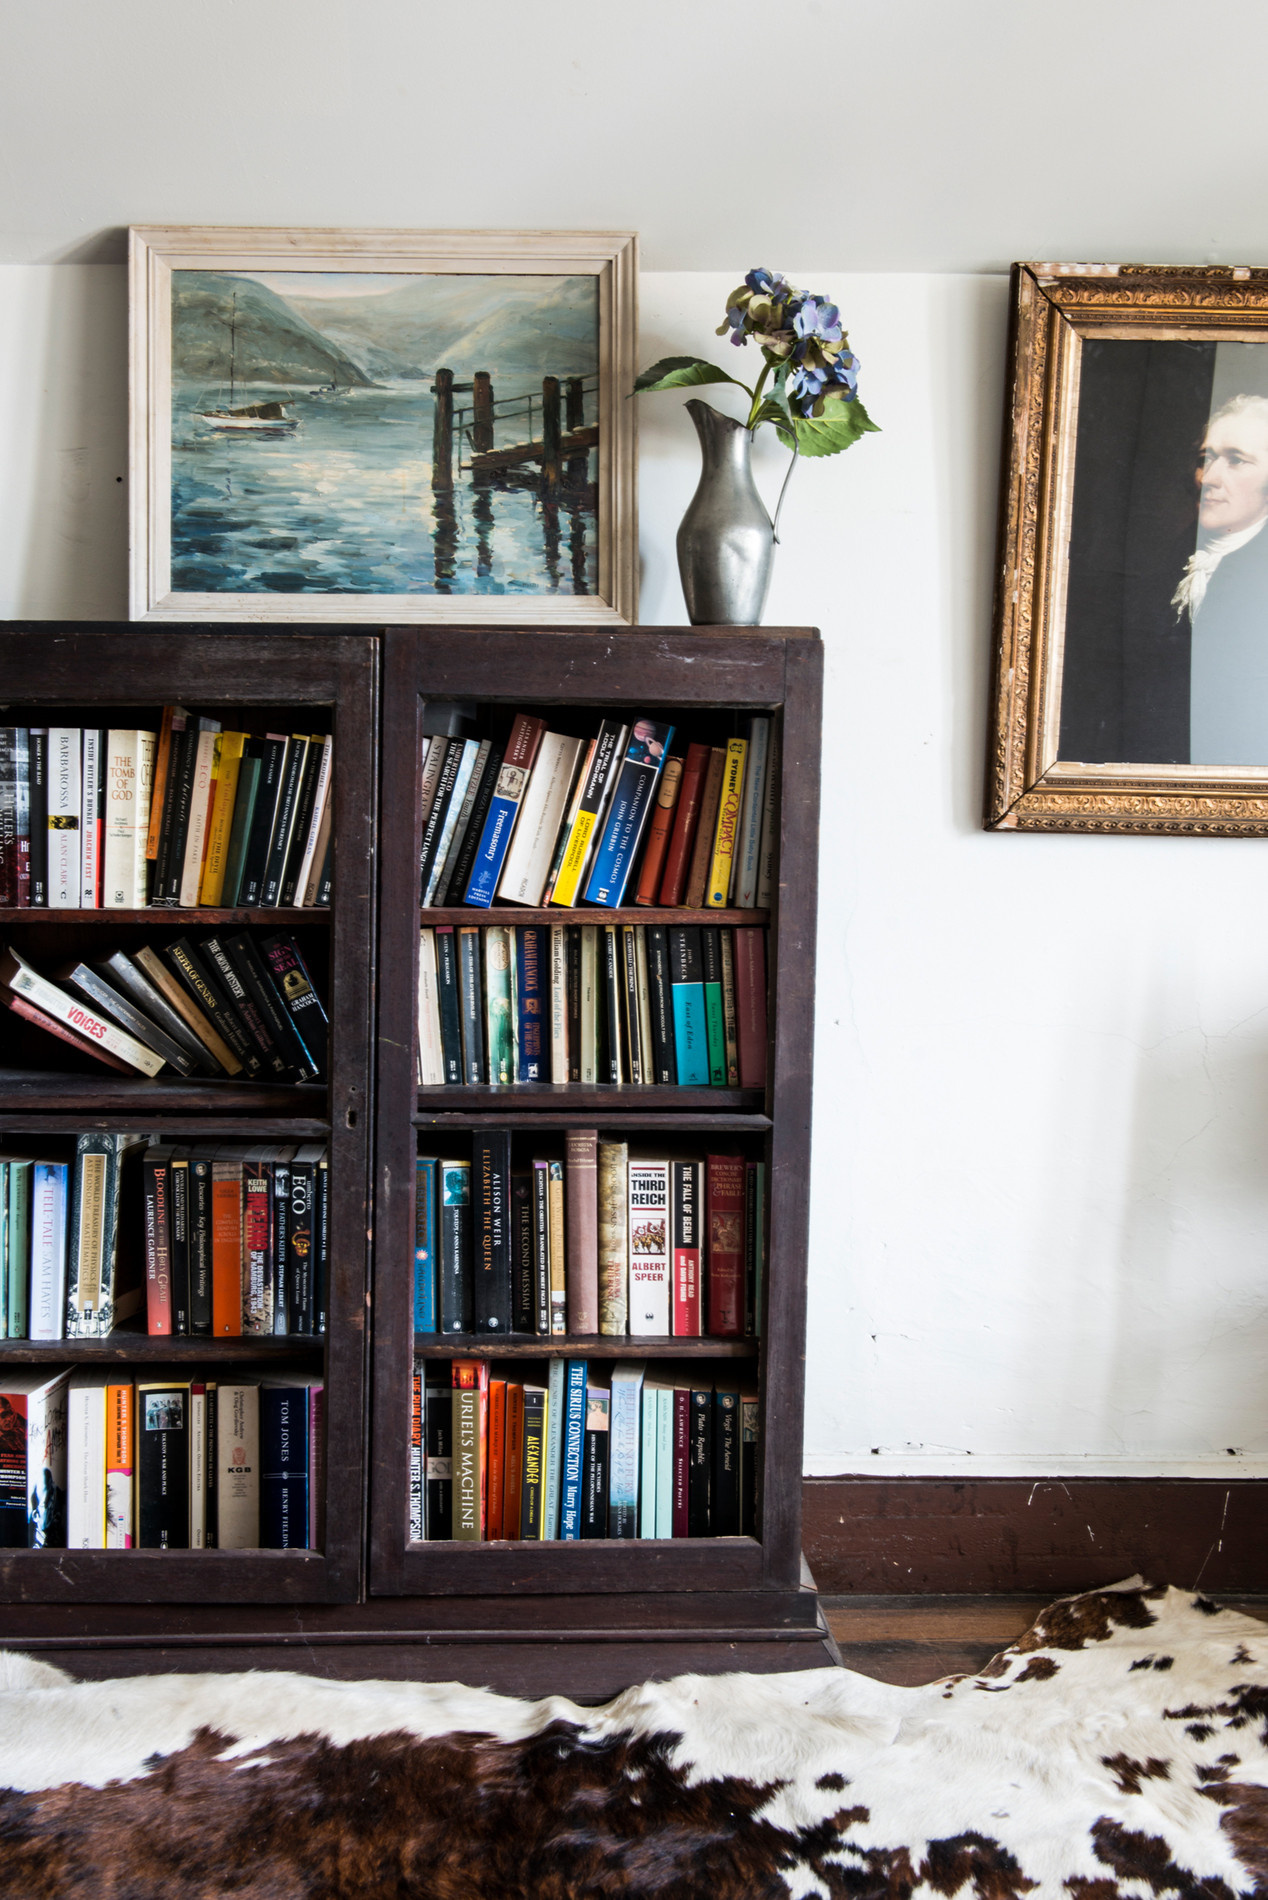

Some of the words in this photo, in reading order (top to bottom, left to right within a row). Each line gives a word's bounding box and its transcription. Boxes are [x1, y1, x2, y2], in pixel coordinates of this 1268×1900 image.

[512, 721, 527, 761] PIATIGORSKY
[519, 725, 532, 760] ALEXANDER
[598, 732, 610, 758] ADOLF
[607, 734, 616, 749] THE
[60, 736, 68, 809] BARBAROSSA
[114, 756, 133, 767] THE
[318, 757, 329, 788] PROPHET
[449, 743, 464, 777] UMBERTO
[600, 750, 611, 772] TRIAL
[109, 767, 135, 779] TOMB
[117, 779, 129, 789] OF
[445, 777, 454, 792] ECO
[586, 758, 603, 799] EICHMANN
[598, 772, 605, 784] OF
[728, 758, 739, 794] SYDNEY
[111, 790, 133, 801] GOD
[628, 774, 647, 821] COMPANION
[3, 794, 15, 845] HITLER'S
[311, 806, 320, 830] KAHLIL
[578, 816, 586, 827] OF
[615, 800, 628, 821] JOHN
[485, 809, 509, 862] Freemasonry
[581, 818, 591, 837] LORD
[607, 822, 621, 852] GRIBBIN
[624, 823, 633, 834] TO
[720, 793, 739, 859] COMPACT
[60, 833, 68, 855] ALAN
[194, 835, 200, 843] IN
[306, 831, 316, 855] GIBRAN
[566, 828, 583, 868] LIVERPOOL
[619, 835, 630, 850] THE
[571, 839, 586, 873] RUSSELL
[609, 852, 623, 884] COSMOS
[60, 858, 68, 885] CLARK
[268, 946, 292, 960] SIGN
[524, 930, 538, 959] GRAHAM
[553, 929, 562, 957] William
[208, 939, 219, 954] THE
[214, 952, 231, 973] ORION
[225, 968, 246, 999] MYSTERY
[273, 958, 299, 974] SEAL
[679, 933, 687, 980] STEINBECK
[173, 946, 191, 973] KEEPER
[188, 969, 199, 980] OF
[196, 977, 218, 1009] GENESIS
[524, 960, 538, 992] HANCOCK
[552, 957, 562, 984] Golding
[291, 992, 314, 1007] GRAHAM
[292, 998, 318, 1012] HANCOCK
[553, 986, 561, 1002] Lord
[553, 1010, 561, 1022] the
[685, 1001, 693, 1019] East
[524, 1022, 532, 1030] OF
[524, 1031, 532, 1041] THE
[553, 1022, 562, 1039] Flies
[685, 1020, 692, 1028] of
[525, 1041, 533, 1056] GODS
[85, 1158, 94, 1210] ASTRONOMY
[482, 1149, 491, 1206] ELIZABETH
[631, 1180, 666, 1191] THIRD
[682, 1166, 692, 1181] THE
[198, 1181, 206, 1211] Descartes
[292, 1175, 306, 1215] ECO
[493, 1173, 501, 1213] ALISON
[632, 1194, 666, 1205] REICH
[682, 1183, 692, 1202] FALL
[146, 1194, 156, 1237] LAURENCE
[279, 1202, 285, 1210] MY
[521, 1204, 529, 1225] THE
[682, 1204, 692, 1215] OF
[197, 1216, 206, 1228] Key
[247, 1192, 268, 1250] INFERNO
[483, 1211, 491, 1230] THE
[493, 1218, 501, 1247] WEIR
[682, 1216, 693, 1244] BERLIN
[82, 1223, 91, 1281] MATHEMATICS
[196, 1229, 206, 1268] Philosophical
[250, 1251, 257, 1260] OF
[482, 1234, 492, 1271] QUEEN
[521, 1226, 530, 1267] SECOND
[147, 1239, 156, 1280] GARDNER
[632, 1263, 666, 1271] ALBERT
[198, 1269, 207, 1297] Writings
[607, 1261, 615, 1301] THIERING
[613, 1262, 621, 1299] BARBARA
[634, 1273, 664, 1281] SPEER
[522, 1269, 530, 1311] MESSIAH
[412, 1376, 421, 1393] THE
[570, 1366, 584, 1387] THE
[281, 1400, 289, 1425] TOM
[412, 1396, 421, 1416] RUM
[569, 1388, 583, 1420] SIRIUS
[412, 1417, 421, 1446] DIARY
[461, 1392, 474, 1446] URIEL'S
[697, 1413, 705, 1431] Plato
[724, 1414, 732, 1432] Virgil
[281, 1427, 289, 1462] JONES
[566, 1421, 581, 1481] CONNECTION
[696, 1436, 705, 1465] Republic
[724, 1438, 732, 1448] The
[411, 1447, 421, 1481] HUNTER
[724, 1449, 732, 1472] Aeneid
[411, 1483, 421, 1492] S.
[461, 1452, 474, 1529] MACHINE
[564, 1485, 577, 1509] Murry
[410, 1492, 421, 1541] THOMPSON
[563, 1510, 577, 1530] Hope
